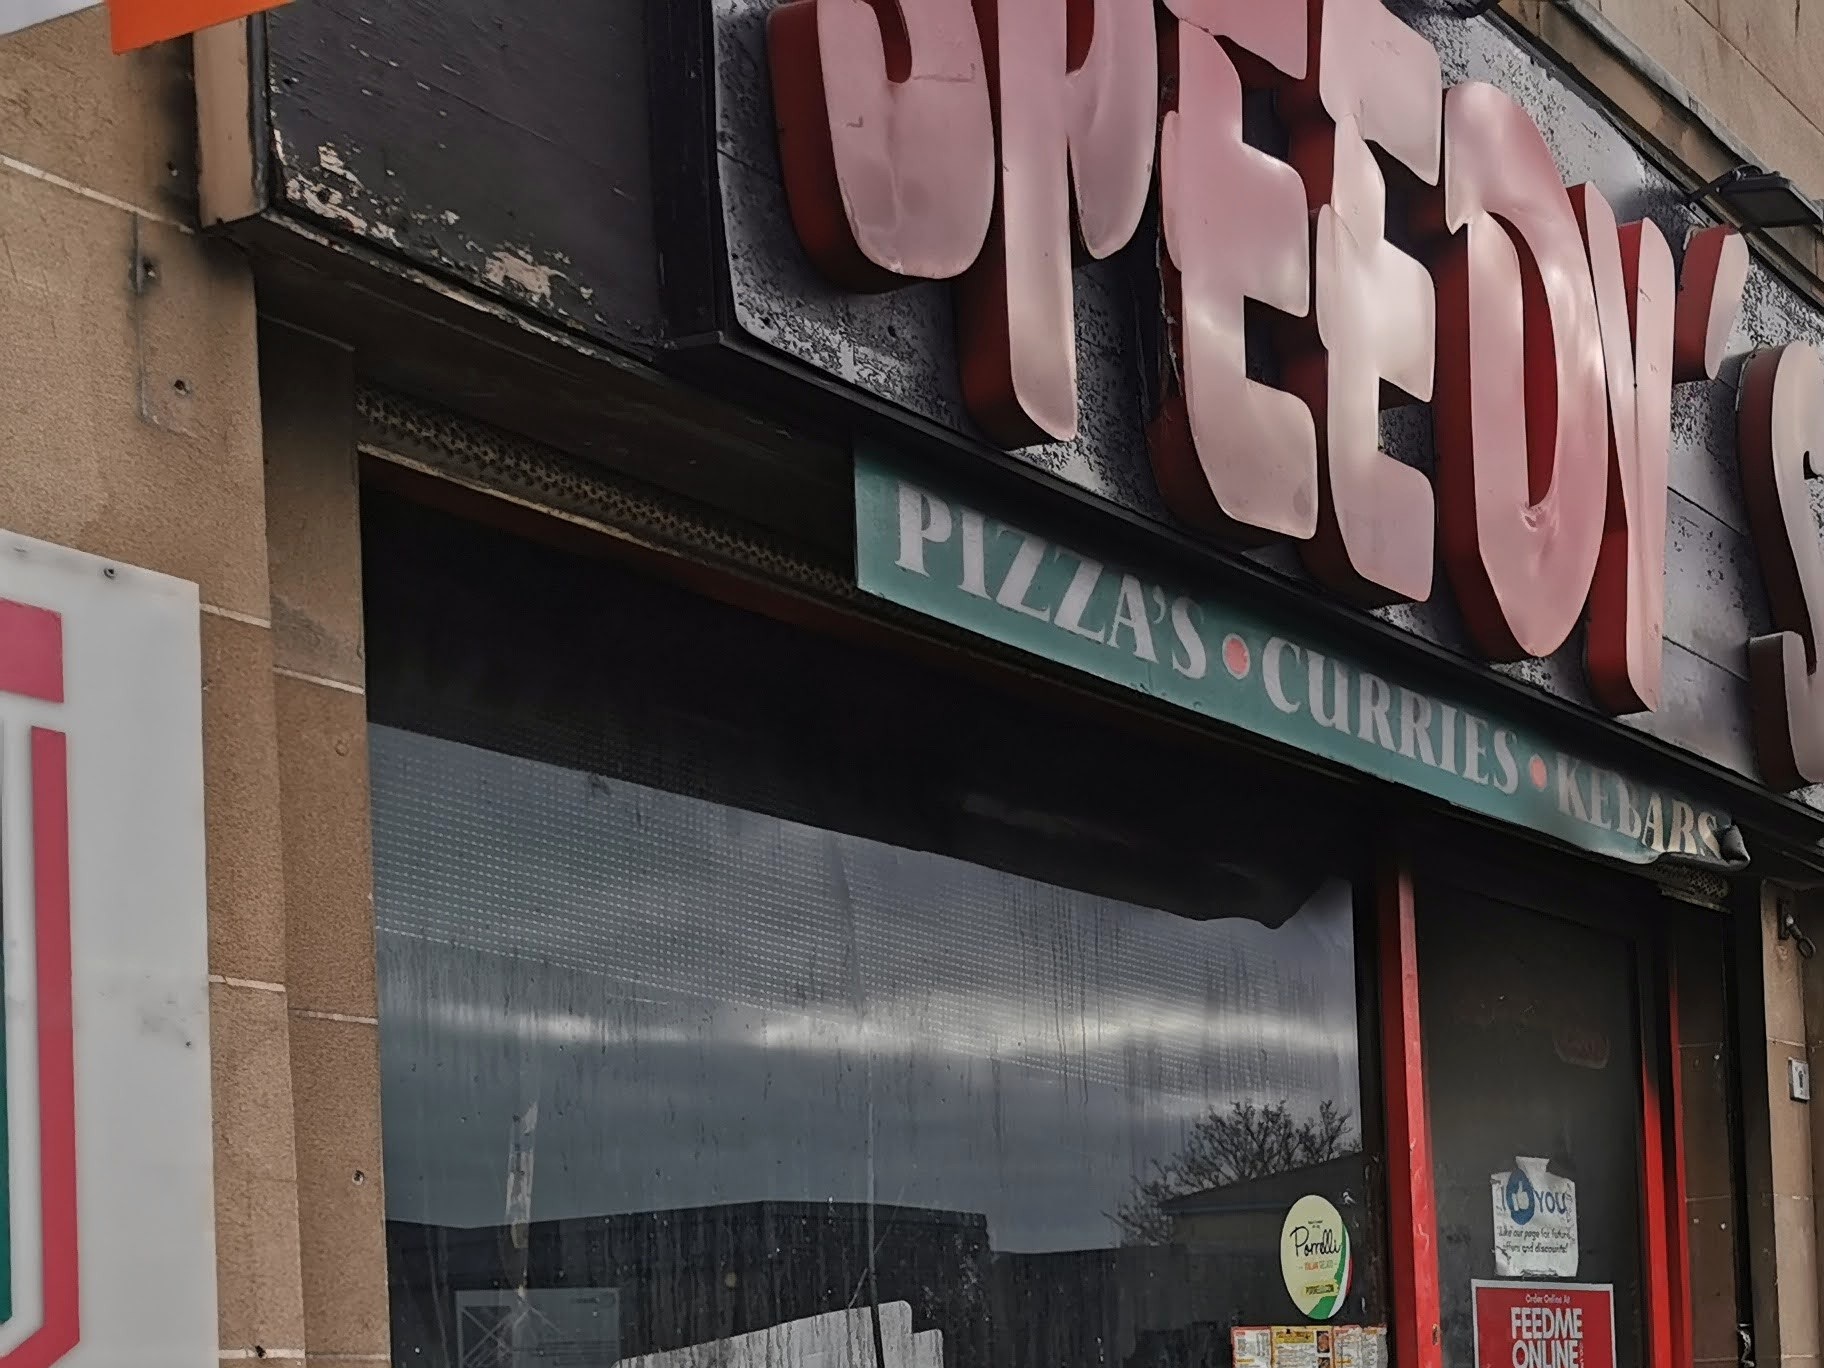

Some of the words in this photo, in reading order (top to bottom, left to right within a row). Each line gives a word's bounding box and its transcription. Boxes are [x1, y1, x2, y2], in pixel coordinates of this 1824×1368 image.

[895, 479, 1207, 681] PIZZA'S
[1261, 634, 1521, 796] CURRIES
[1533, 1188, 1568, 1215] YOU
[1289, 1225, 1342, 1258] Porrelli
[1510, 1306, 1584, 1340] FEEDME
